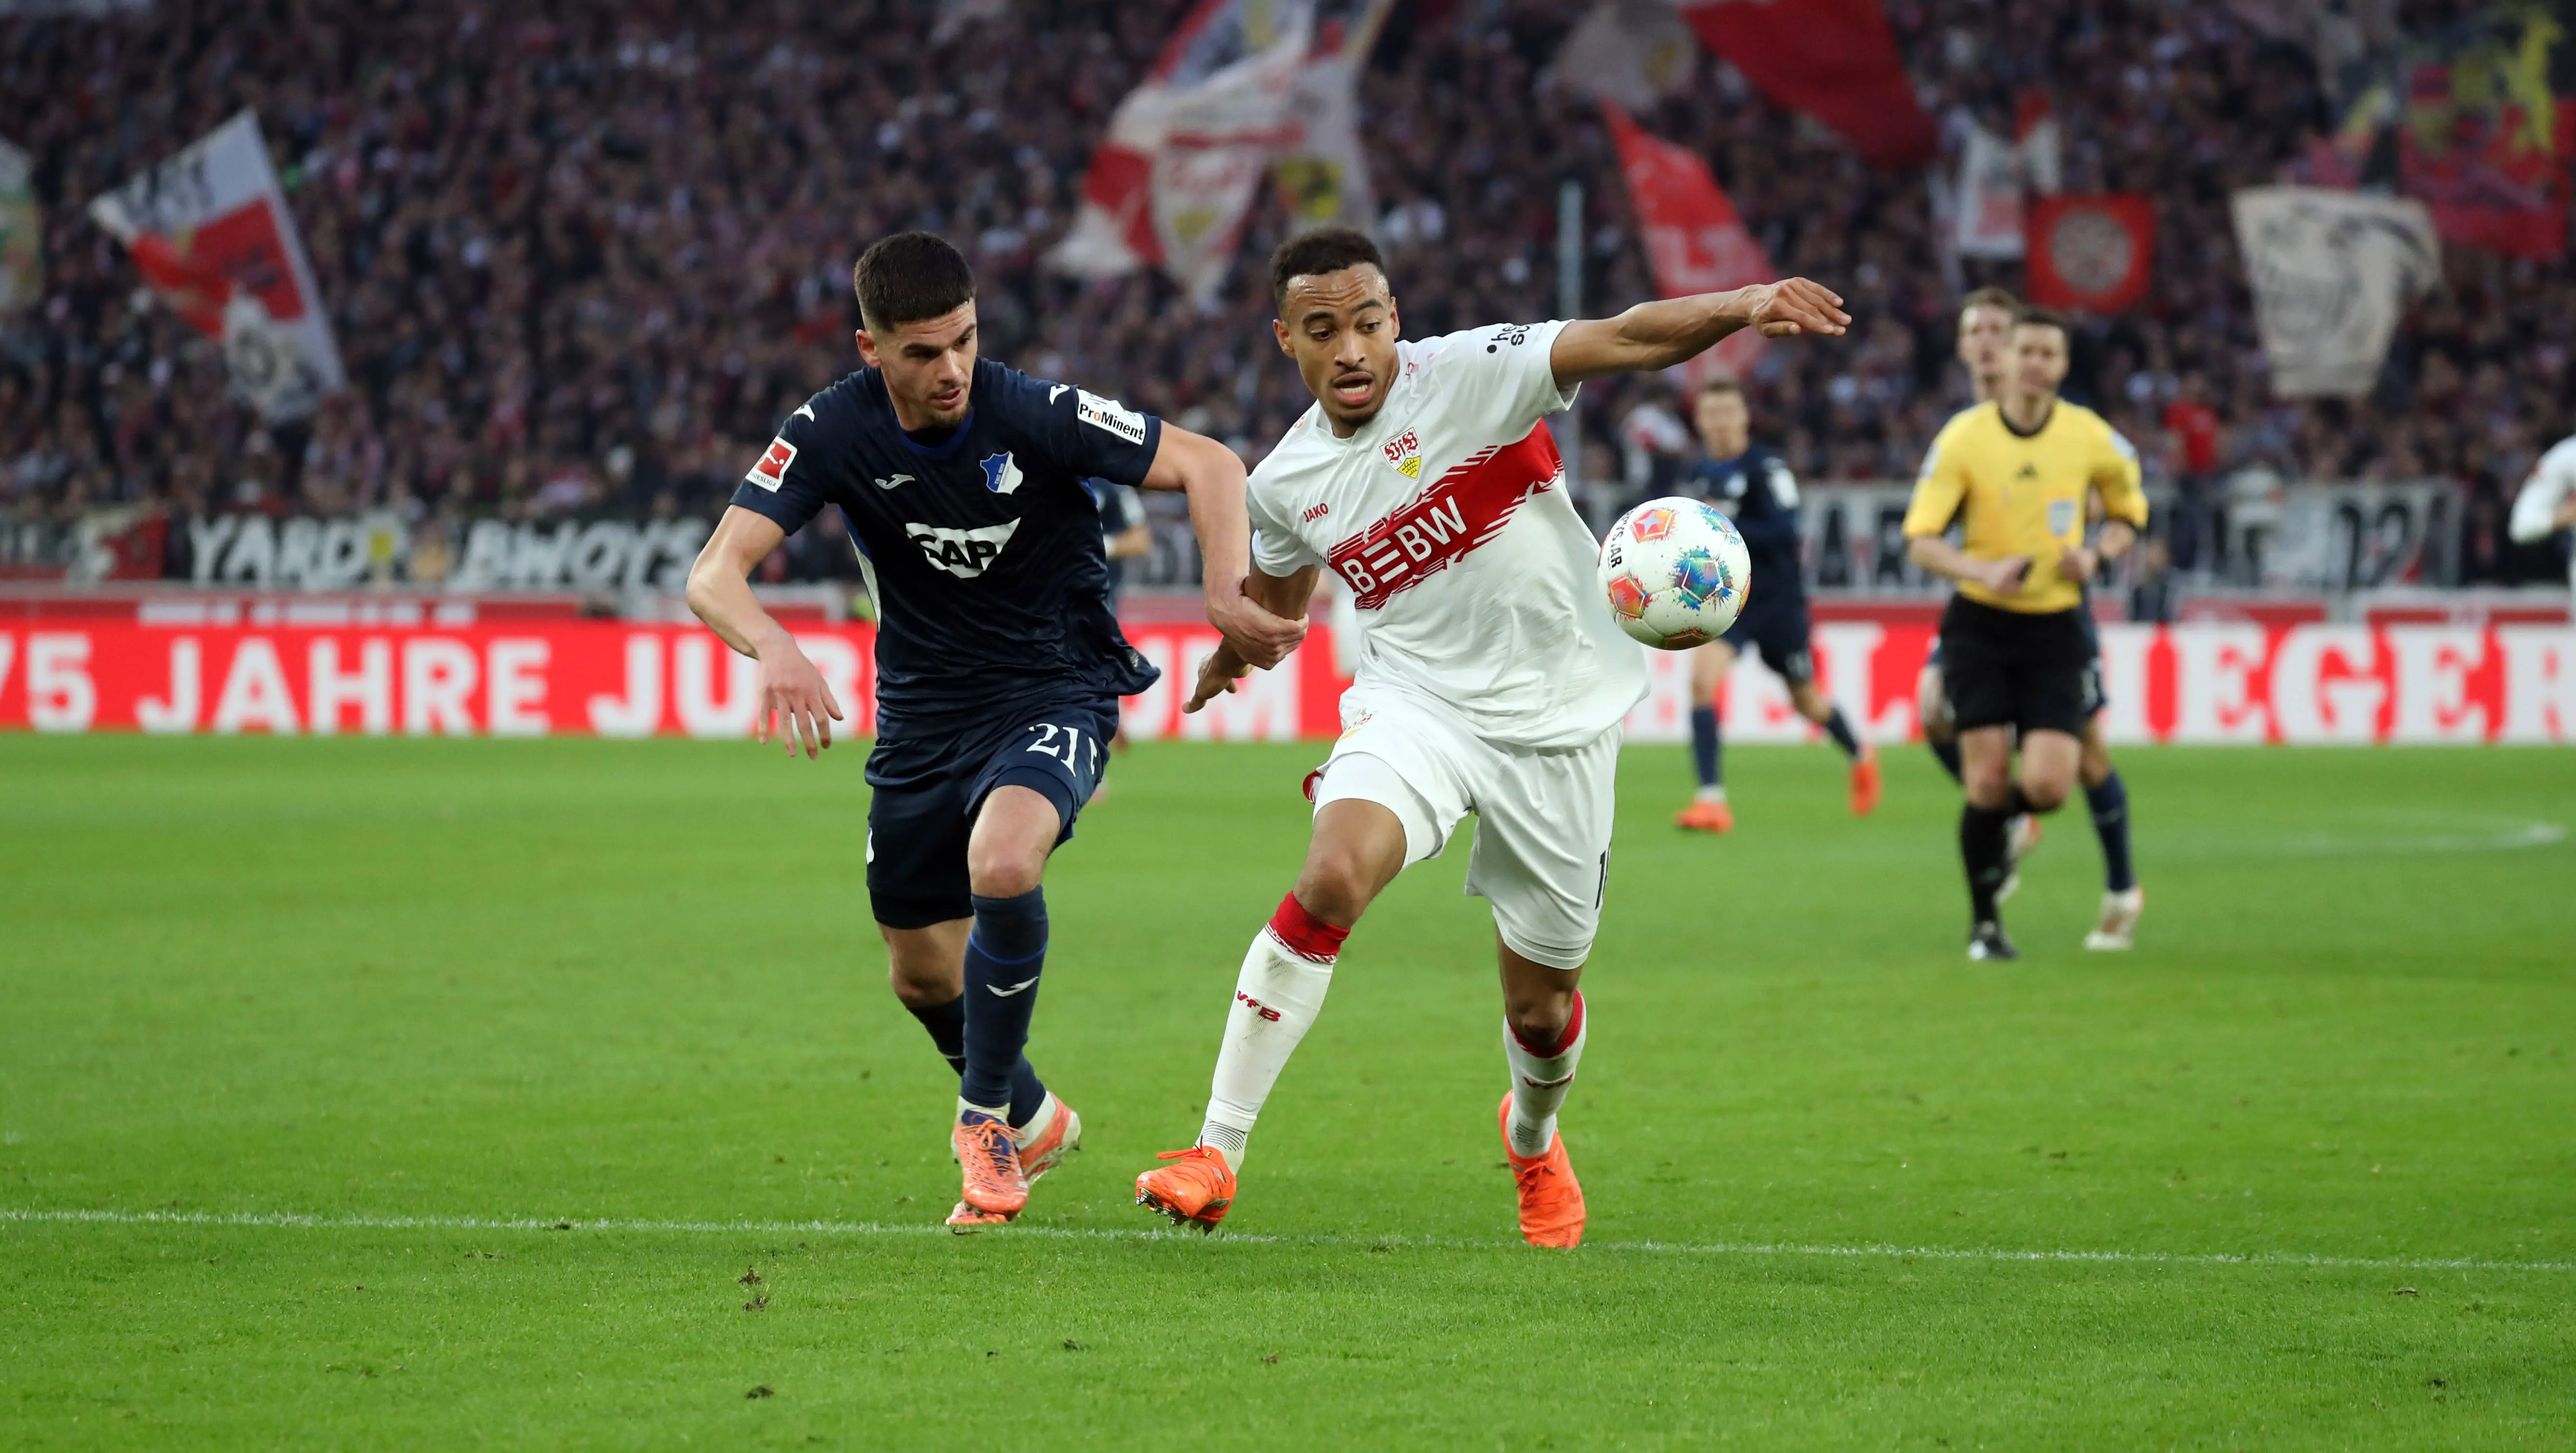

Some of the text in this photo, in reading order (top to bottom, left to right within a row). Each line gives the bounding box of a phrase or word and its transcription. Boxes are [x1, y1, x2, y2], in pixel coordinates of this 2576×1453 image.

[1079, 403, 1144, 440] ProMinent
[1303, 503, 1328, 522] JAKO
[909, 533, 997, 569] SAP
[0, 632, 97, 734] 5
[135, 635, 551, 737] JAHRE
[1026, 723, 1079, 777] 21
[1595, 841, 1611, 910] 1
